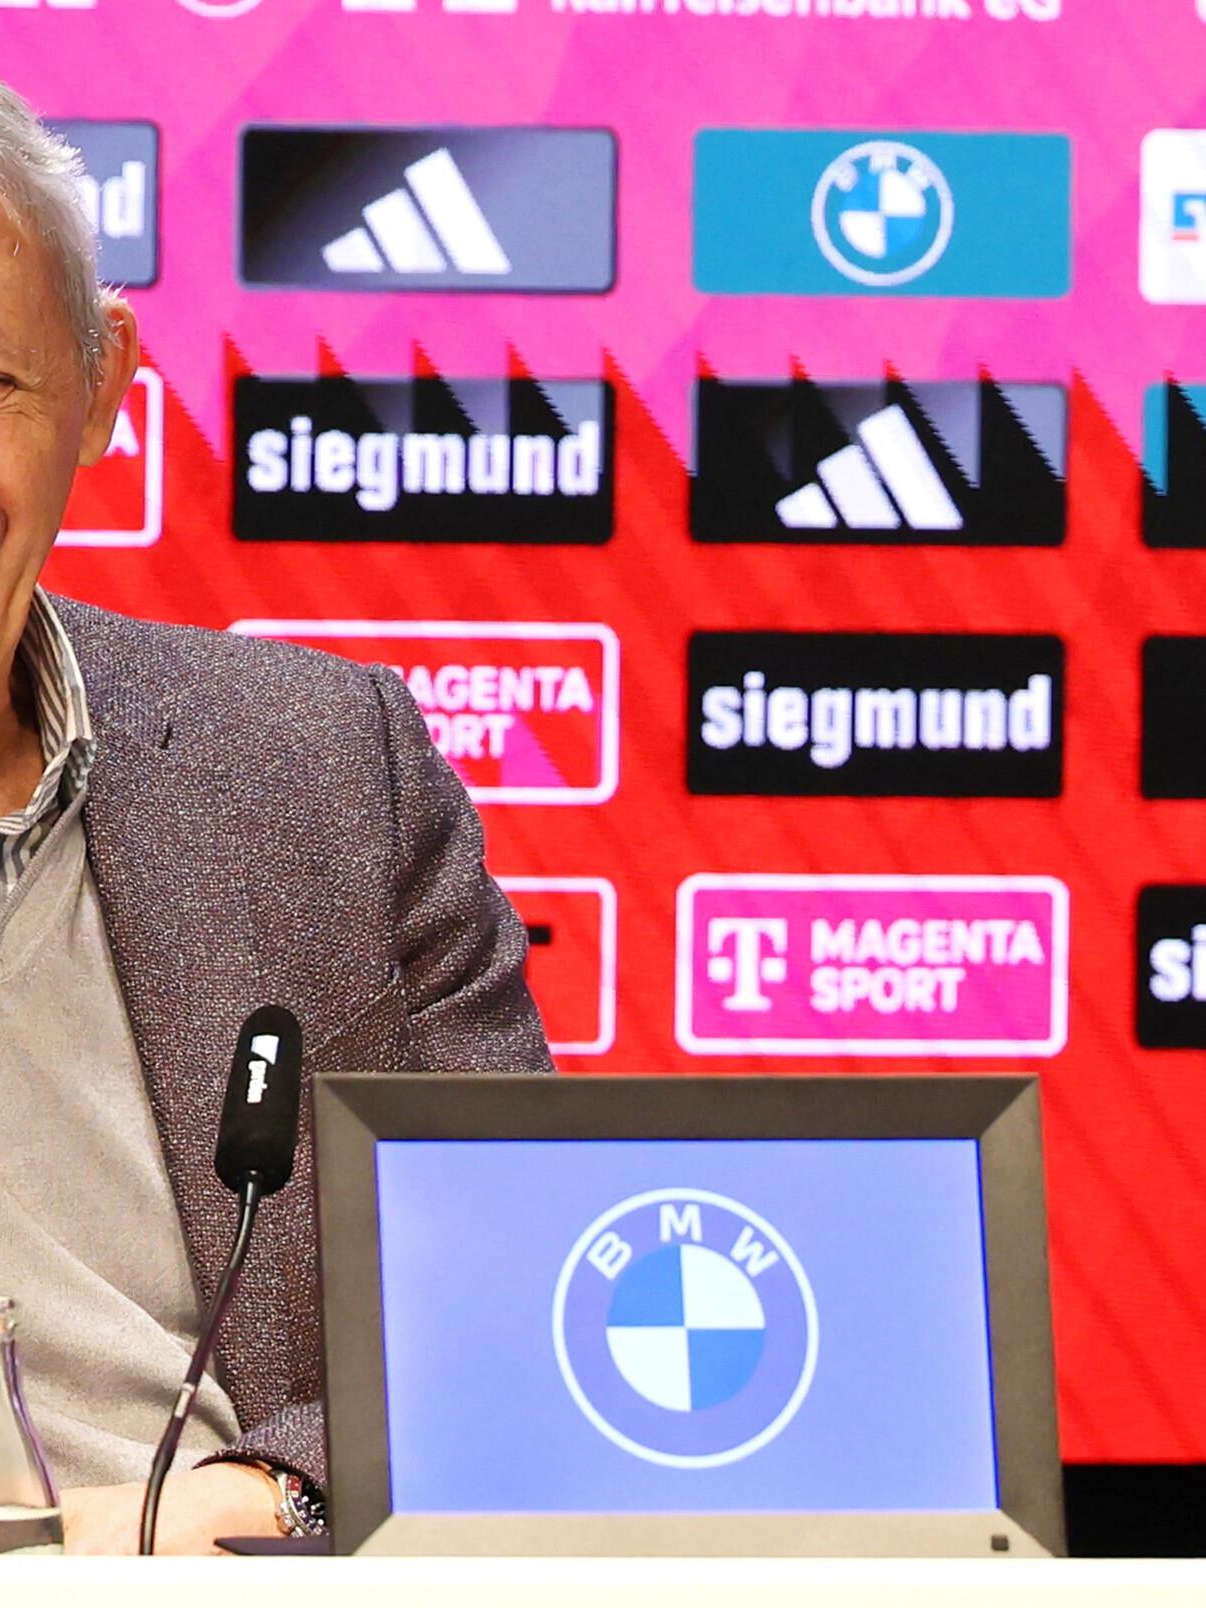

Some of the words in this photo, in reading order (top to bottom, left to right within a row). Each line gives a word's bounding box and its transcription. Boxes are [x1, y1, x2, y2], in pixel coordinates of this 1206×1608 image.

[247, 414, 600, 512] siegmund
[394, 664, 594, 712] AGENTA
[424, 712, 516, 759] ORT
[700, 671, 1052, 769] siegmund
[810, 918, 1045, 967] MAGENTA
[810, 967, 967, 1015] SPORT
[585, 1202, 780, 1281] BMW
